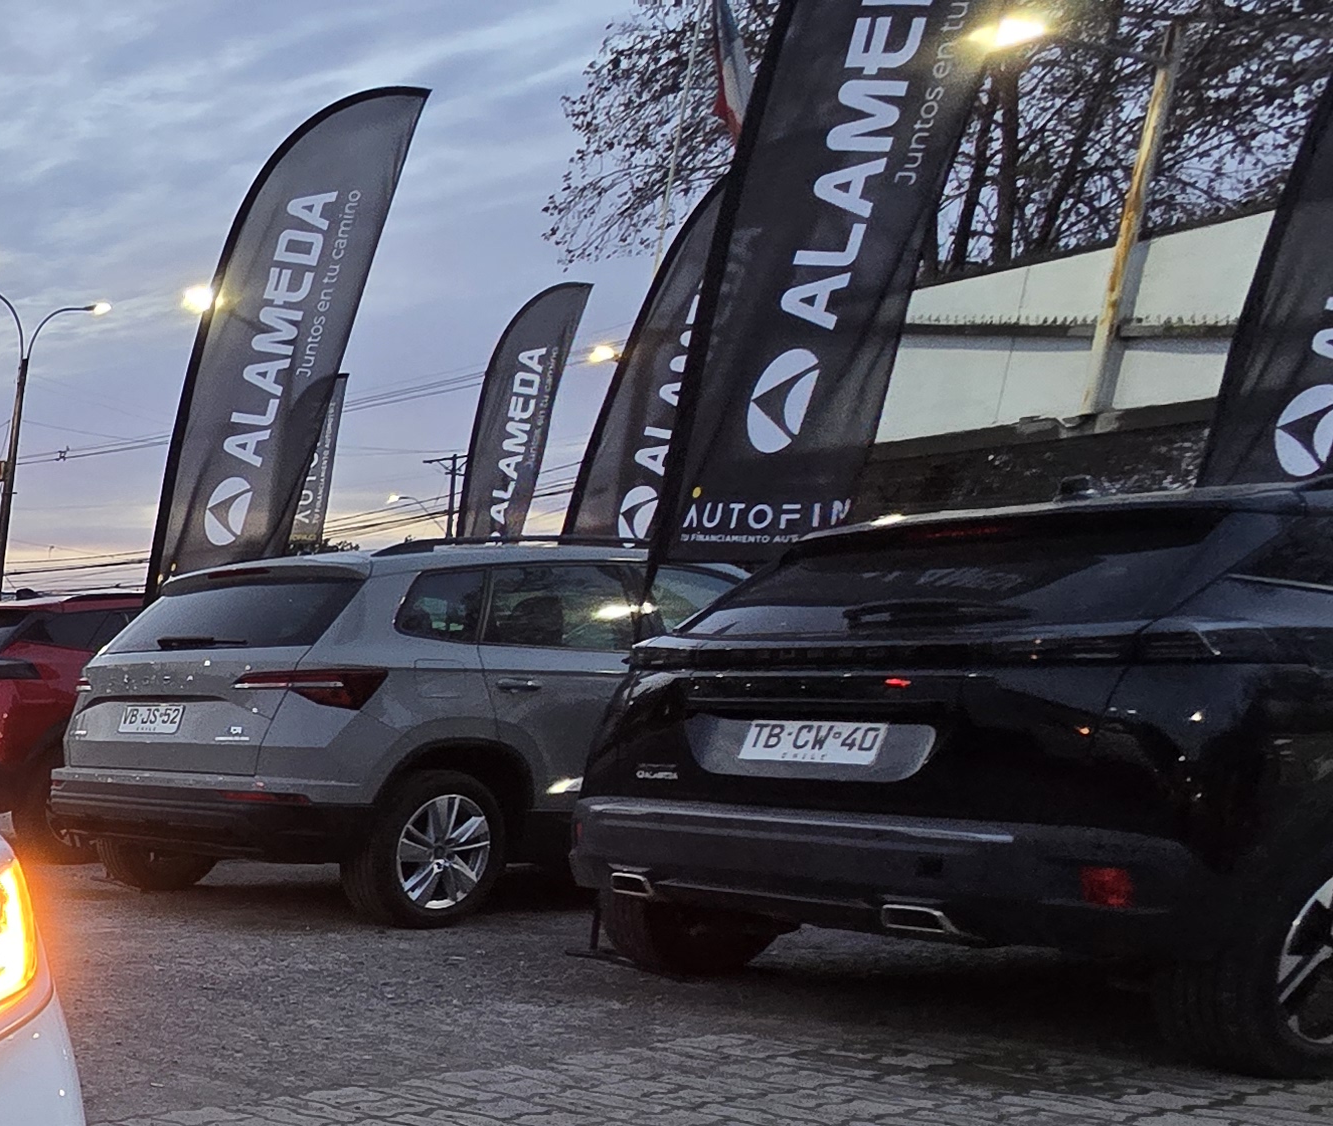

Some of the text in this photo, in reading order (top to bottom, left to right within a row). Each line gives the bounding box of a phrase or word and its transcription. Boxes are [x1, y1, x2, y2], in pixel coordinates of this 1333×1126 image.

[781, 0, 933, 330] ALAME
[894, 2, 970, 186] Juntos en tu
[223, 191, 338, 467] ALAMEDA
[296, 189, 362, 377] Juntos en tu camino
[490, 347, 547, 524] ALAMEDA
[683, 498, 852, 530] AUTOFIN
